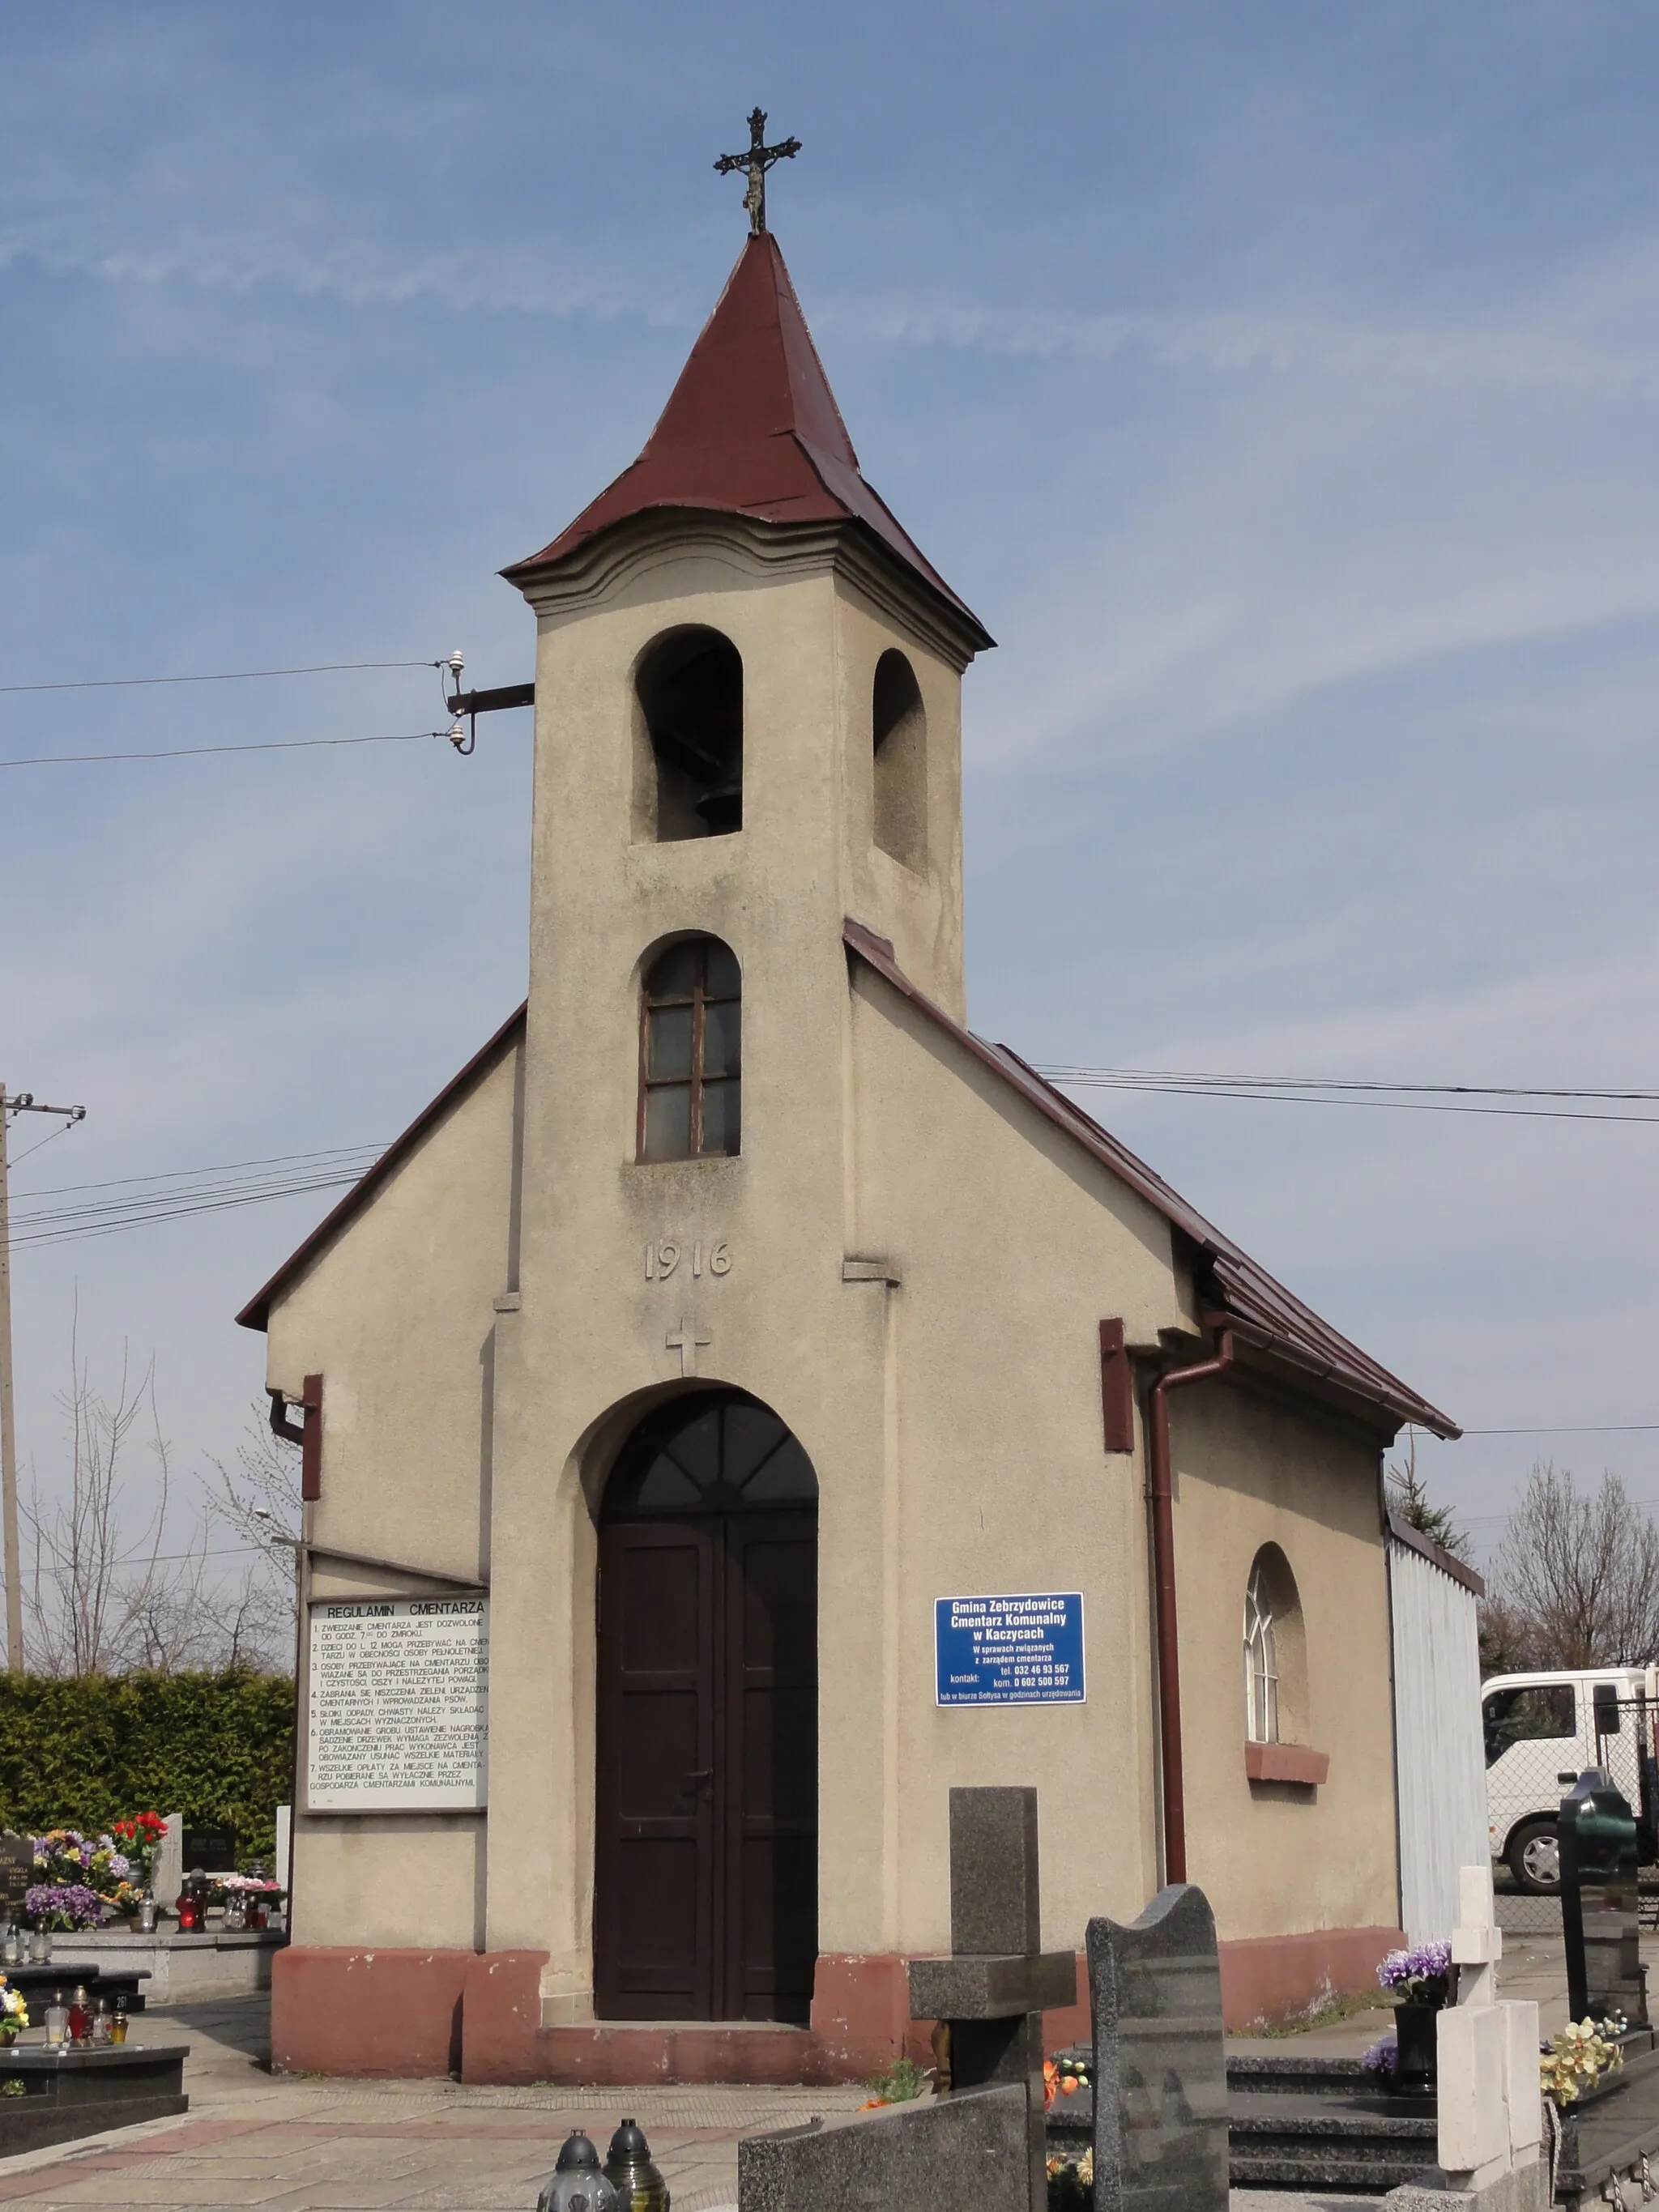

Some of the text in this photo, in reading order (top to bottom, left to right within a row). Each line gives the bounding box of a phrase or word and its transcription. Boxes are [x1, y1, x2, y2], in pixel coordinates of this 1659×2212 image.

[646, 1241, 731, 1280] 1916
[328, 1602, 484, 1618] REGULAMIN CMENTARZA
[953, 1598, 1064, 1613] Gmina Zebrzydowice
[367, 1622, 412, 1630] CMENTARZA
[437, 1619, 483, 1627] DOZWOLONE
[951, 1613, 1066, 1627] Cmentarz Komunalny
[974, 1627, 1043, 1642] w Kaczycach
[360, 1649, 399, 1658] OBECNOŚCI
[982, 1644, 1013, 1654] sprawach
[1016, 1643, 1054, 1652] związanych
[983, 1656, 1014, 1664] zarządem
[386, 1668, 450, 1676] PRZESTRZEGANIA
[1001, 1664, 1069, 1675] tel. 032 46 93 567
[950, 1674, 979, 1683] kontakt:
[994, 1677, 1069, 1687] kom. 0 602 500 597
[979, 1692, 1000, 1700] Sołtysa
[1009, 1690, 1040, 1699] godzinach
[1043, 1690, 1081, 1698] urzędowania
[320, 1698, 373, 1707] CMENTARNYCH
[383, 1696, 440, 1704] WPROWADZANIA
[378, 1708, 413, 1716] CHWASTY
[331, 1717, 370, 1725] MIEJSCACH
[319, 1728, 372, 1736] OBRAMOWANIE
[396, 1734, 429, 1742] WYMAGA
[433, 1733, 479, 1741] ZEZWOLENIA
[409, 1742, 457, 1750] WYKONAWCA
[404, 1751, 439, 1759] WSZELKIE
[318, 1764, 353, 1772] WSZELKIE
[310, 1781, 358, 1790] GOSPODARZA
[363, 1780, 416, 1788] CMENTARZAMI
